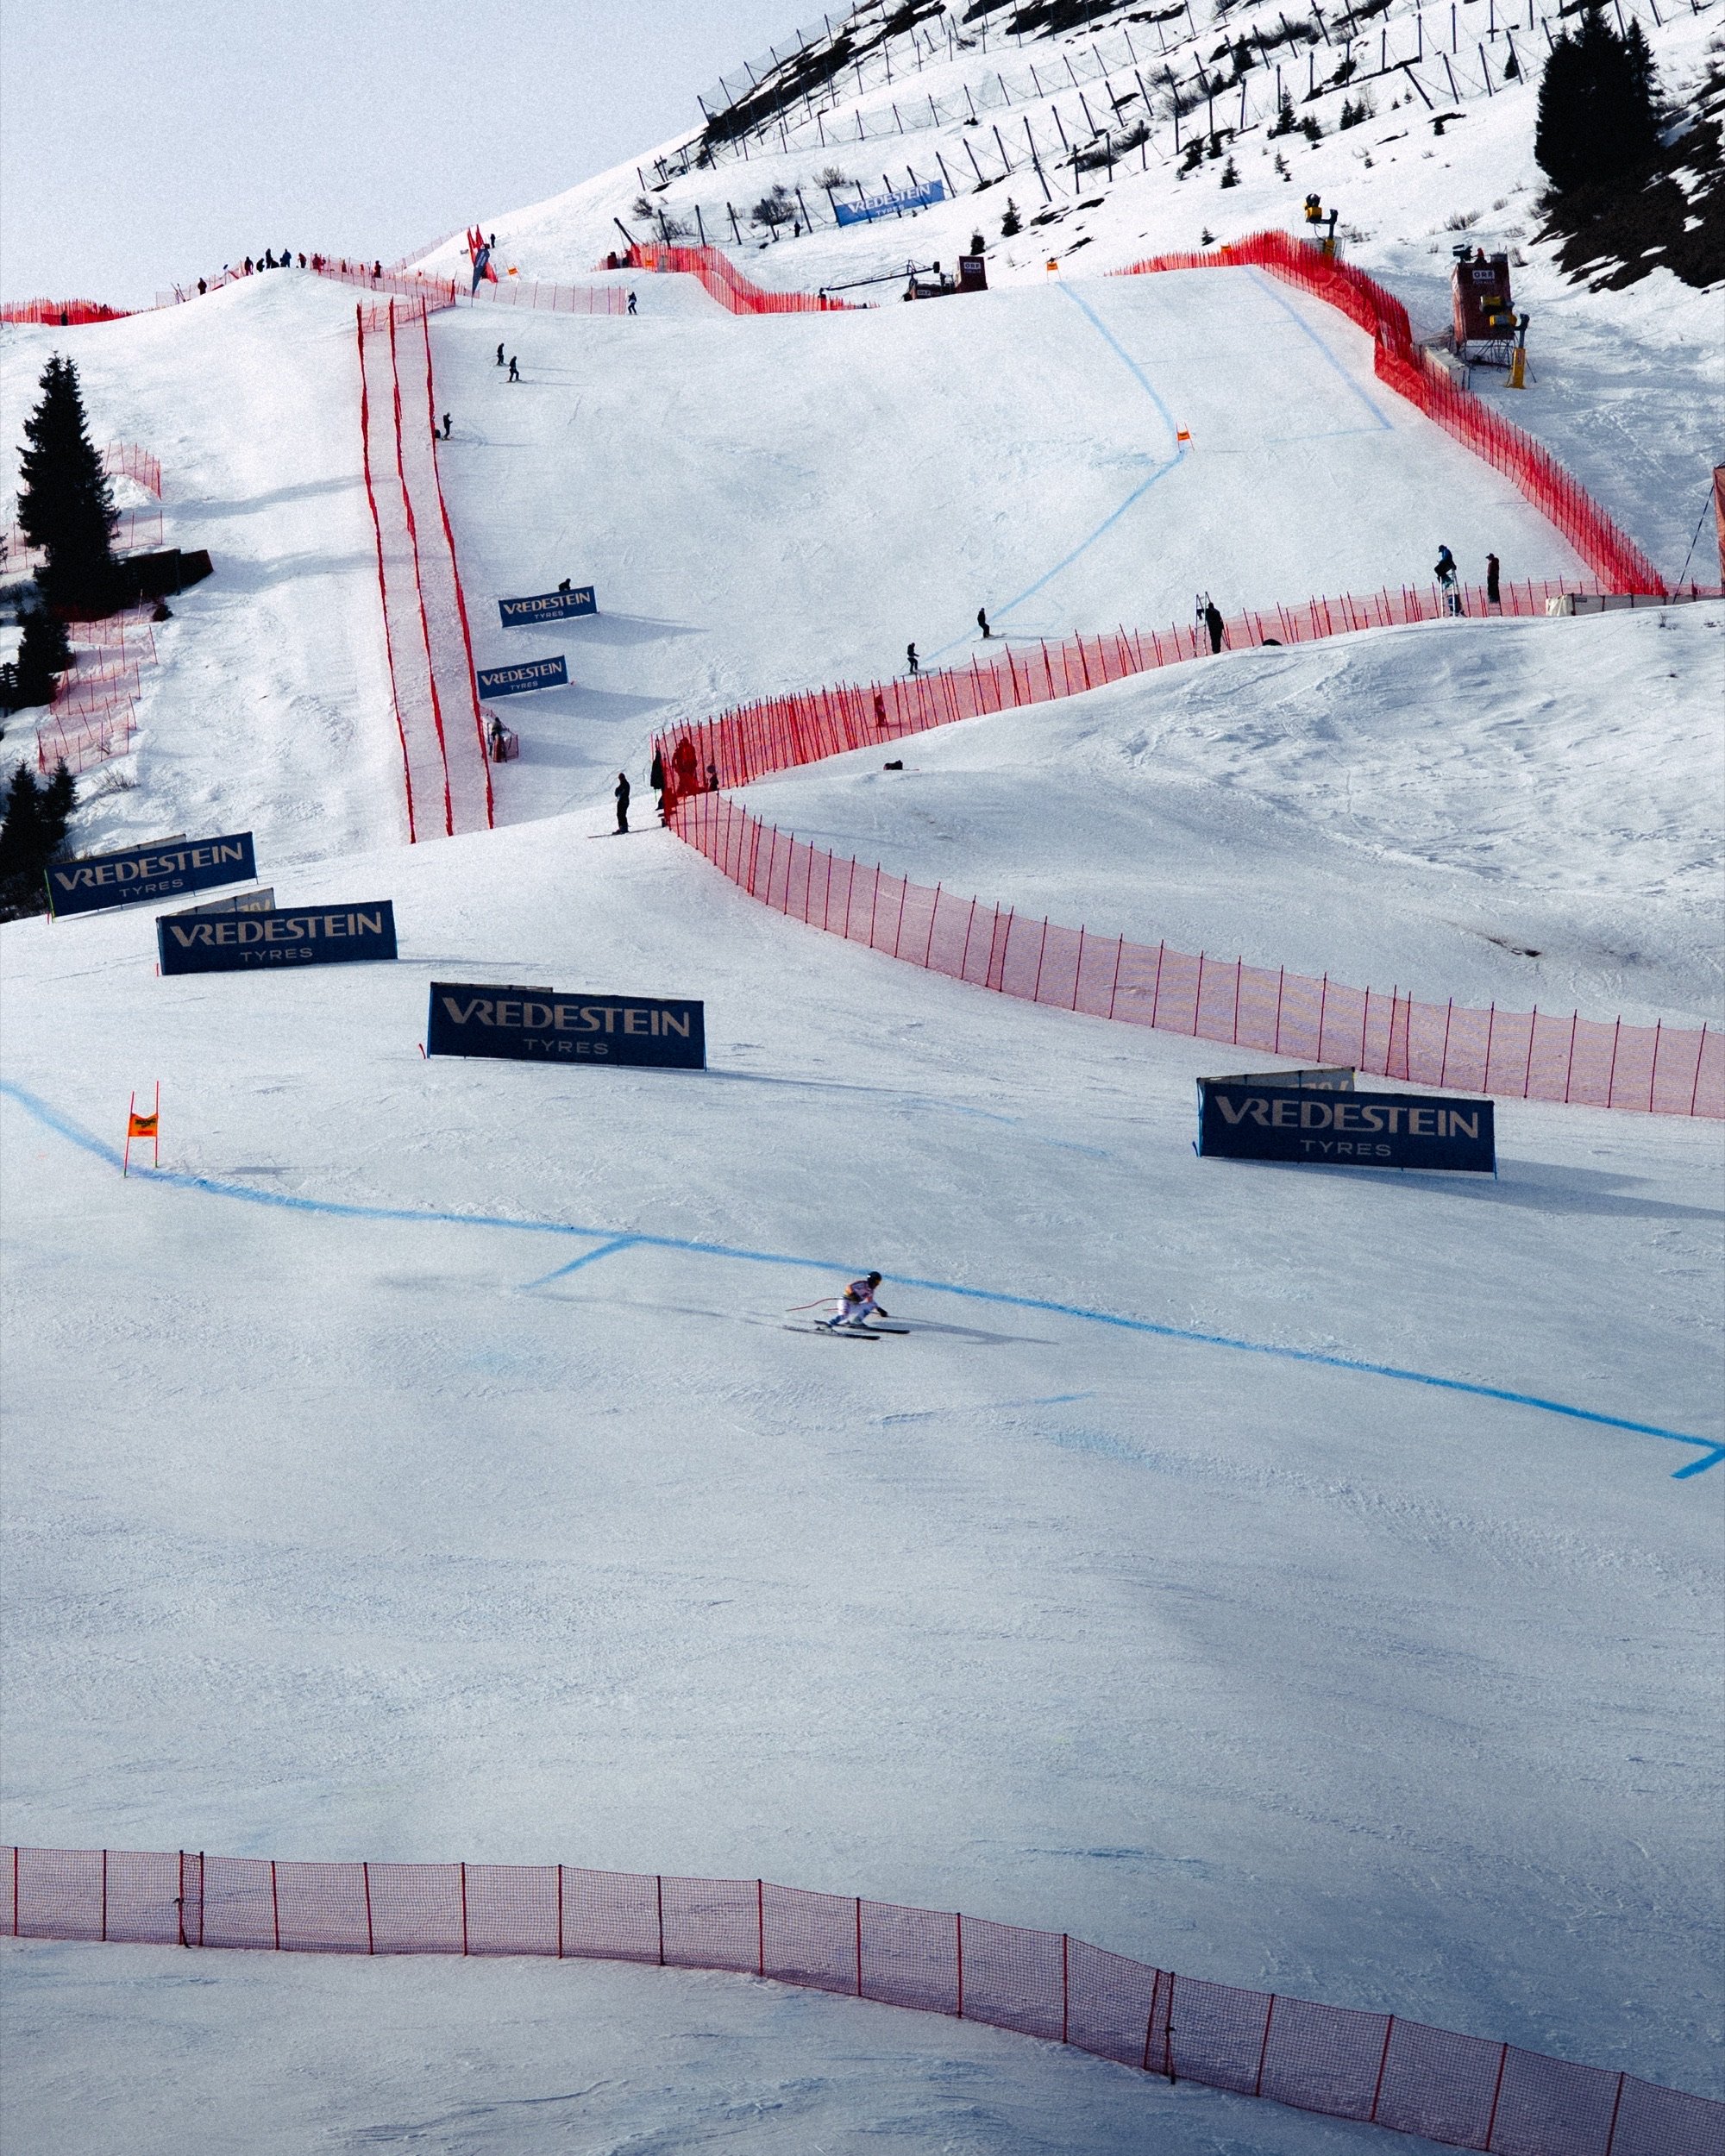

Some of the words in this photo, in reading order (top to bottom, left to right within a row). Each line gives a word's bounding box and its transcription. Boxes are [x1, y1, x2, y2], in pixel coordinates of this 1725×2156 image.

[848, 185, 931, 213] VREDESTEIN
[503, 592, 591, 615] VREDESTEIN
[534, 611, 564, 620] TYRES
[480, 661, 562, 686] VREDESTEIN
[510, 681, 538, 691] TYRES
[54, 843, 243, 891] VREDESTEIN
[119, 879, 184, 898] TYRES
[170, 912, 382, 947] VREDESTEIN
[240, 948, 313, 962] TYRES
[442, 997, 690, 1037] VREDESTEIN
[523, 1038, 609, 1055] TYRES
[1214, 1096, 1478, 1138] VREDESTEIN
[1300, 1140, 1392, 1156] TYRES
